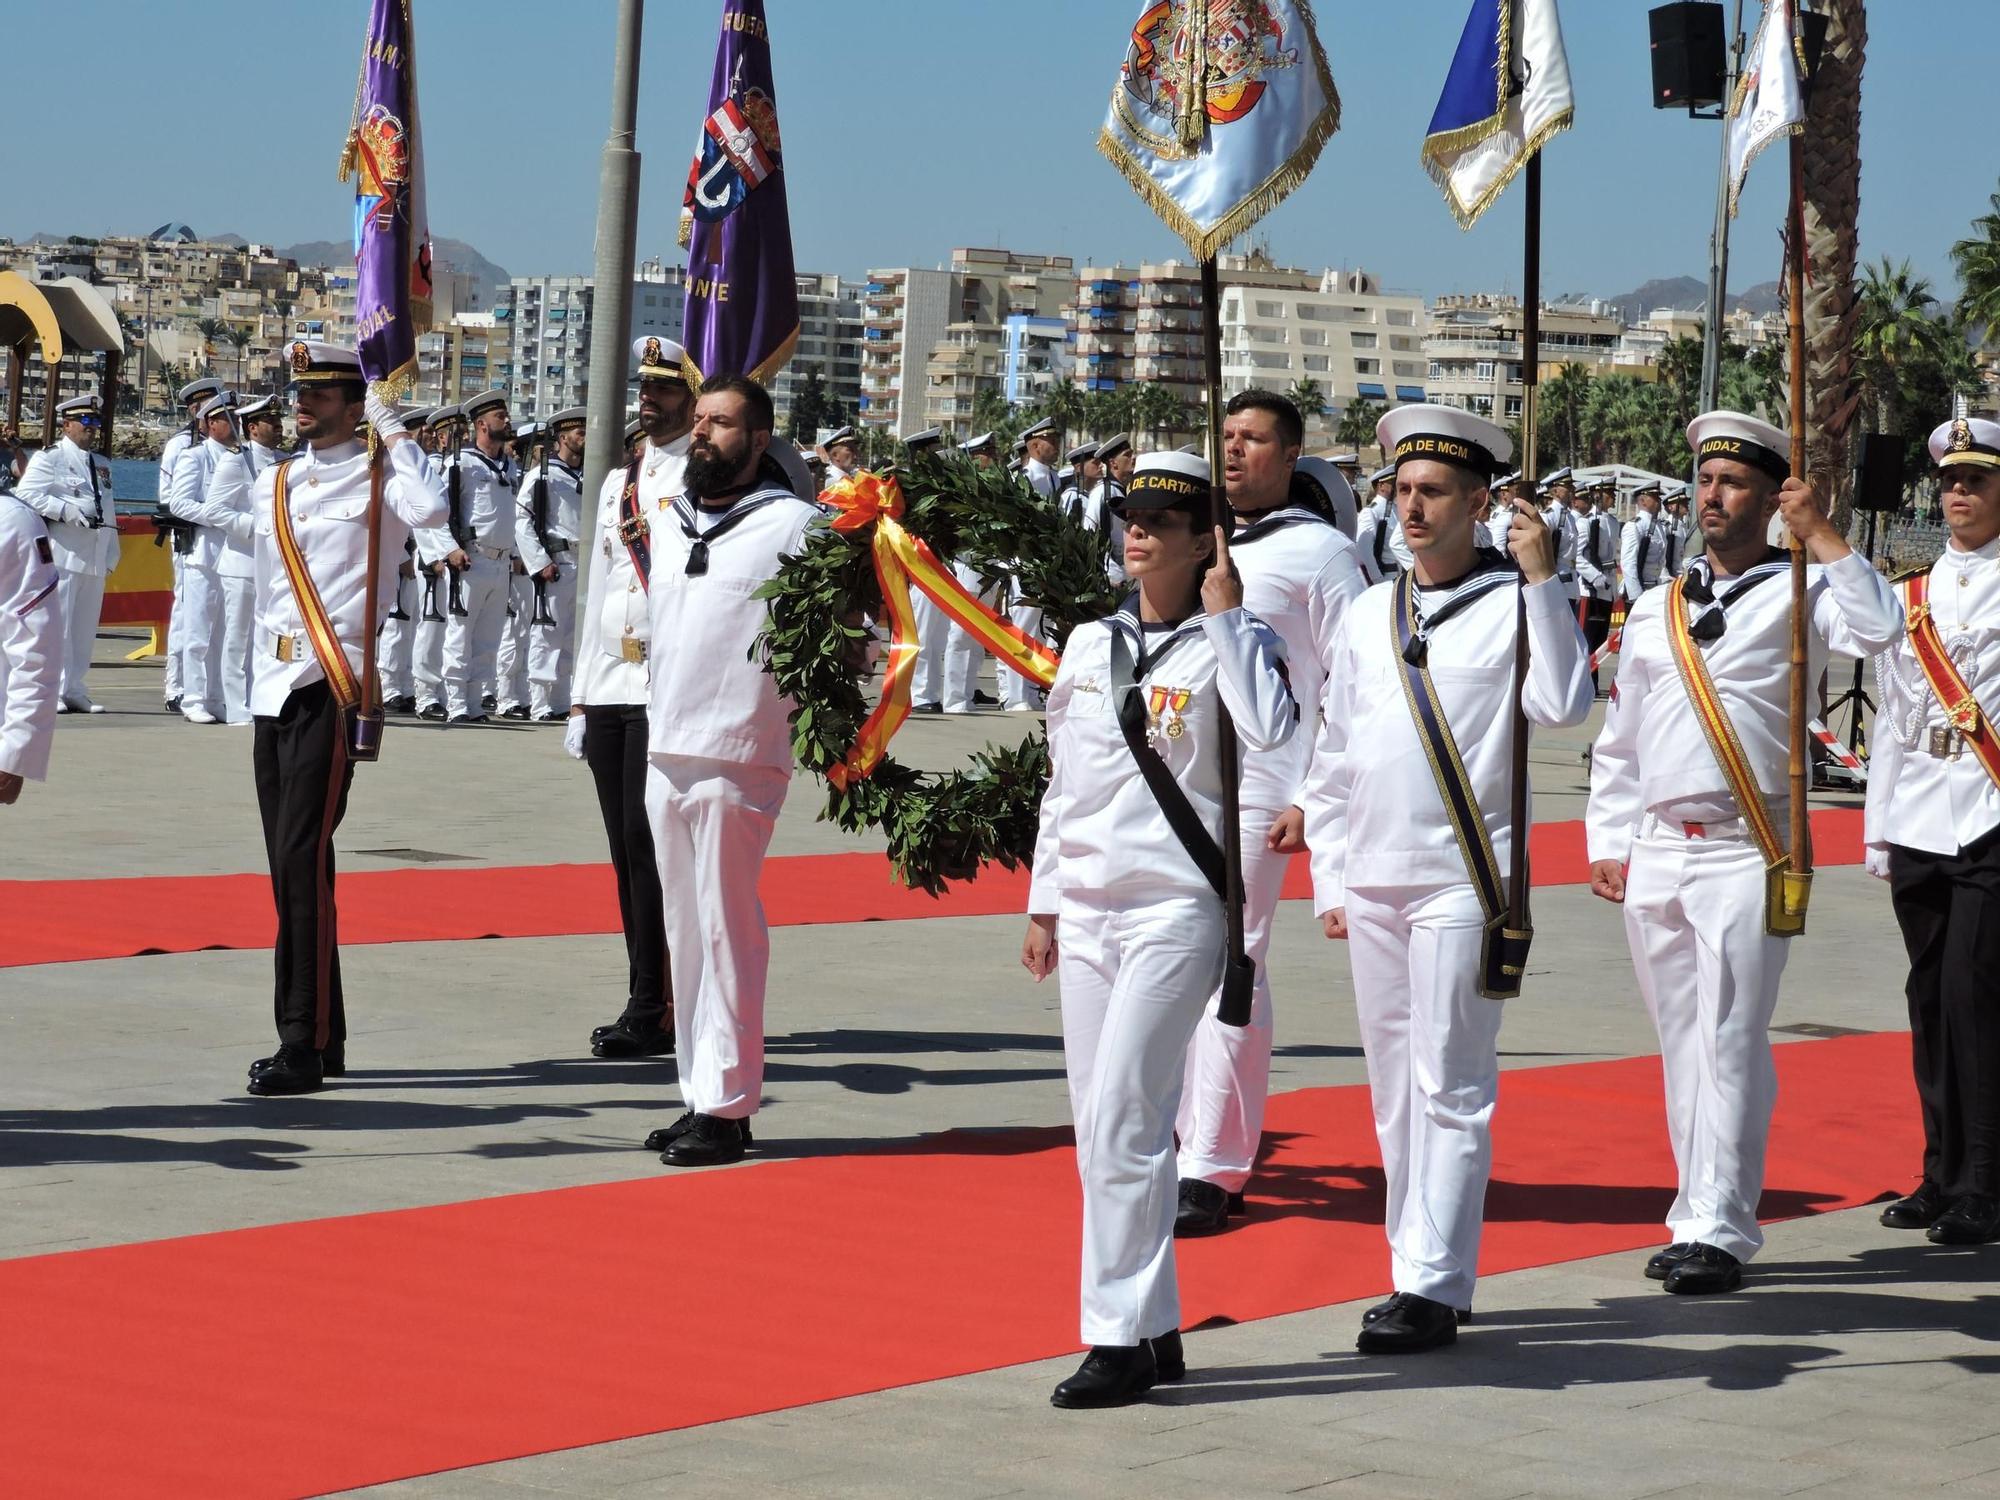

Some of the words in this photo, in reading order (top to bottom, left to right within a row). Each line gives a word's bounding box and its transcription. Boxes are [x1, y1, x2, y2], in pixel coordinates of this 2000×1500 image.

[1416, 440, 1435, 451] DE
[1437, 441, 1468, 459] MCM
[1701, 440, 1741, 454] AUDAZ
[1132, 476, 1147, 491] DE
